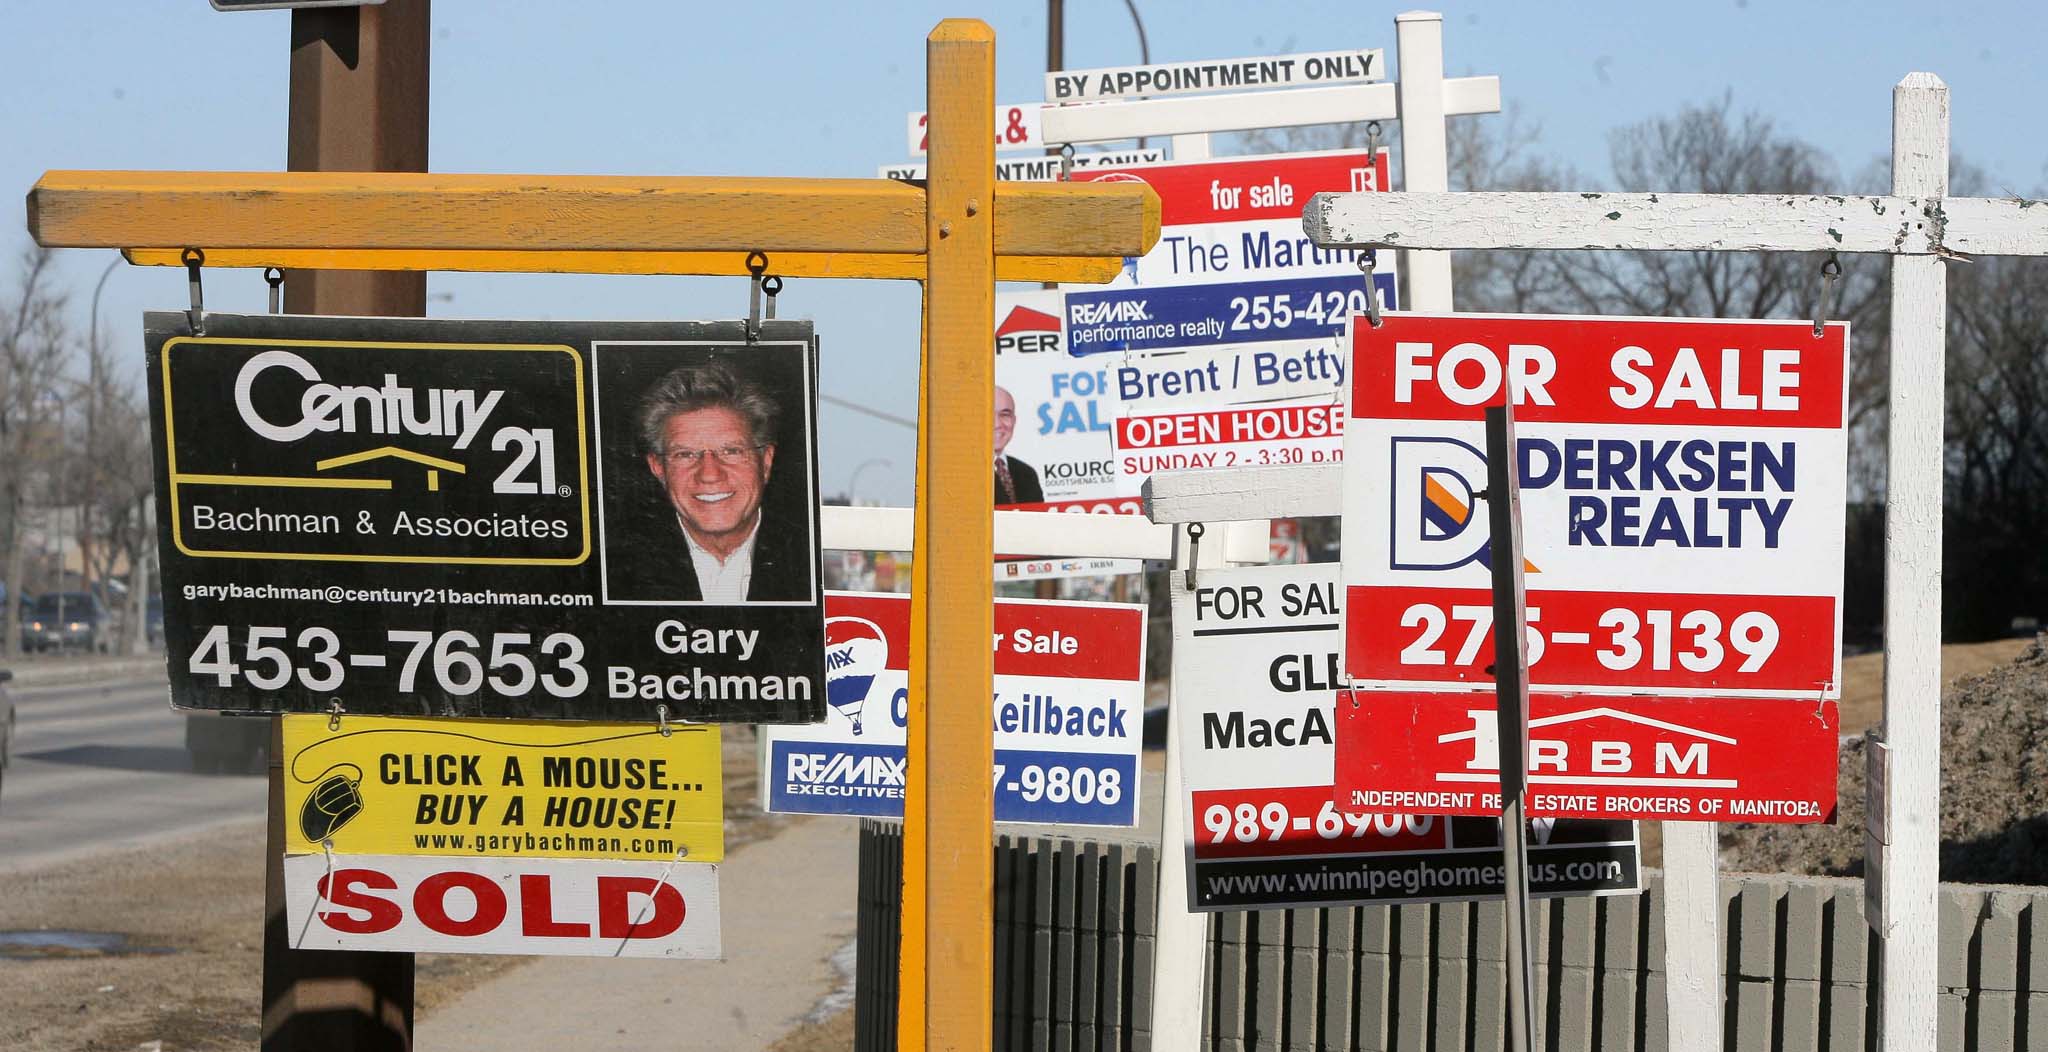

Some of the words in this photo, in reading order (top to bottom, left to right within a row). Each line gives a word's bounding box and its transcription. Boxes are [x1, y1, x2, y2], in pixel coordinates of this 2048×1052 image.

[1054, 76, 1088, 98] BY
[1099, 60, 1295, 94] APPOINTMENT
[1304, 54, 1374, 81] ONLY
[1211, 180, 1245, 211] for
[1249, 177, 1294, 209] sale
[1163, 235, 1229, 275] The
[1073, 322, 1176, 347] performance
[1181, 319, 1226, 339] realty
[1118, 360, 1221, 400] Brent
[1254, 348, 1344, 387] Betty
[1394, 341, 1557, 406] FOR
[1609, 345, 1801, 411] SALE
[234, 350, 505, 450] Century
[1037, 401, 1110, 436] SAL
[1126, 414, 1221, 447] OPEN
[1232, 407, 1343, 441] HOUSE
[491, 426, 556, 496] 21
[1124, 451, 1218, 475] SUNDAY
[1225, 451, 1236, 466] 2
[1259, 447, 1303, 465] 3:30
[1516, 437, 1796, 493] DERKSEN
[192, 505, 340, 535] Bachman
[356, 511, 375, 536] &
[392, 510, 569, 540] Associates
[1569, 495, 1794, 548] REALTY
[182, 580, 594, 607] garybachman@century21bachman.com
[1196, 585, 1266, 621] FOR
[1281, 581, 1339, 617] SAL
[654, 620, 760, 661] Gary
[1013, 628, 1079, 655] Sale
[188, 625, 589, 698] 453-7653
[608, 667, 811, 701] Bachman
[380, 753, 483, 787] CLICK
[502, 755, 525, 787] A
[543, 756, 703, 791] MOUSE...
[787, 752, 906, 786] RE/MAX
[415, 794, 489, 826] BUY
[502, 796, 524, 827] A
[543, 798, 677, 830] HOUSE!
[1534, 795, 1598, 812] ESTATE
[1605, 797, 1692, 815] BROKERS
[1698, 799, 1723, 815] OF
[1730, 799, 1822, 817] MANITOBA
[414, 832, 674, 854] www.garybachman.com
[1208, 858, 1622, 895] www.winnipeghomesus.com
[318, 868, 687, 940] SOLD
